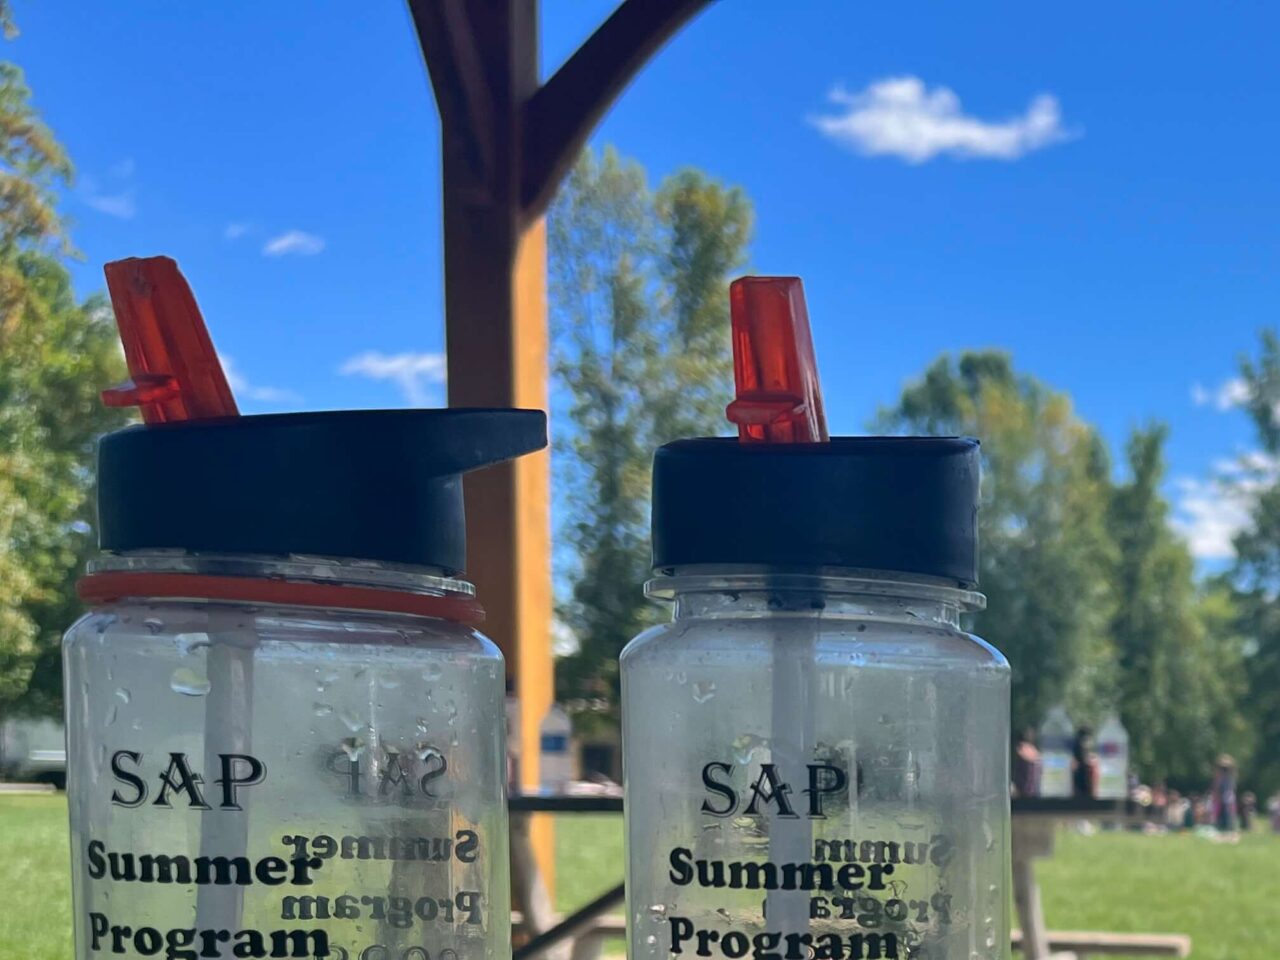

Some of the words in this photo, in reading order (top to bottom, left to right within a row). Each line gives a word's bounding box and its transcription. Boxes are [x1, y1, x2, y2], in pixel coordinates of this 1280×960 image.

[111, 750, 267, 811] SAP
[700, 761, 848, 820] SAP
[87, 839, 323, 886] Summer
[668, 847, 895, 892] Summer
